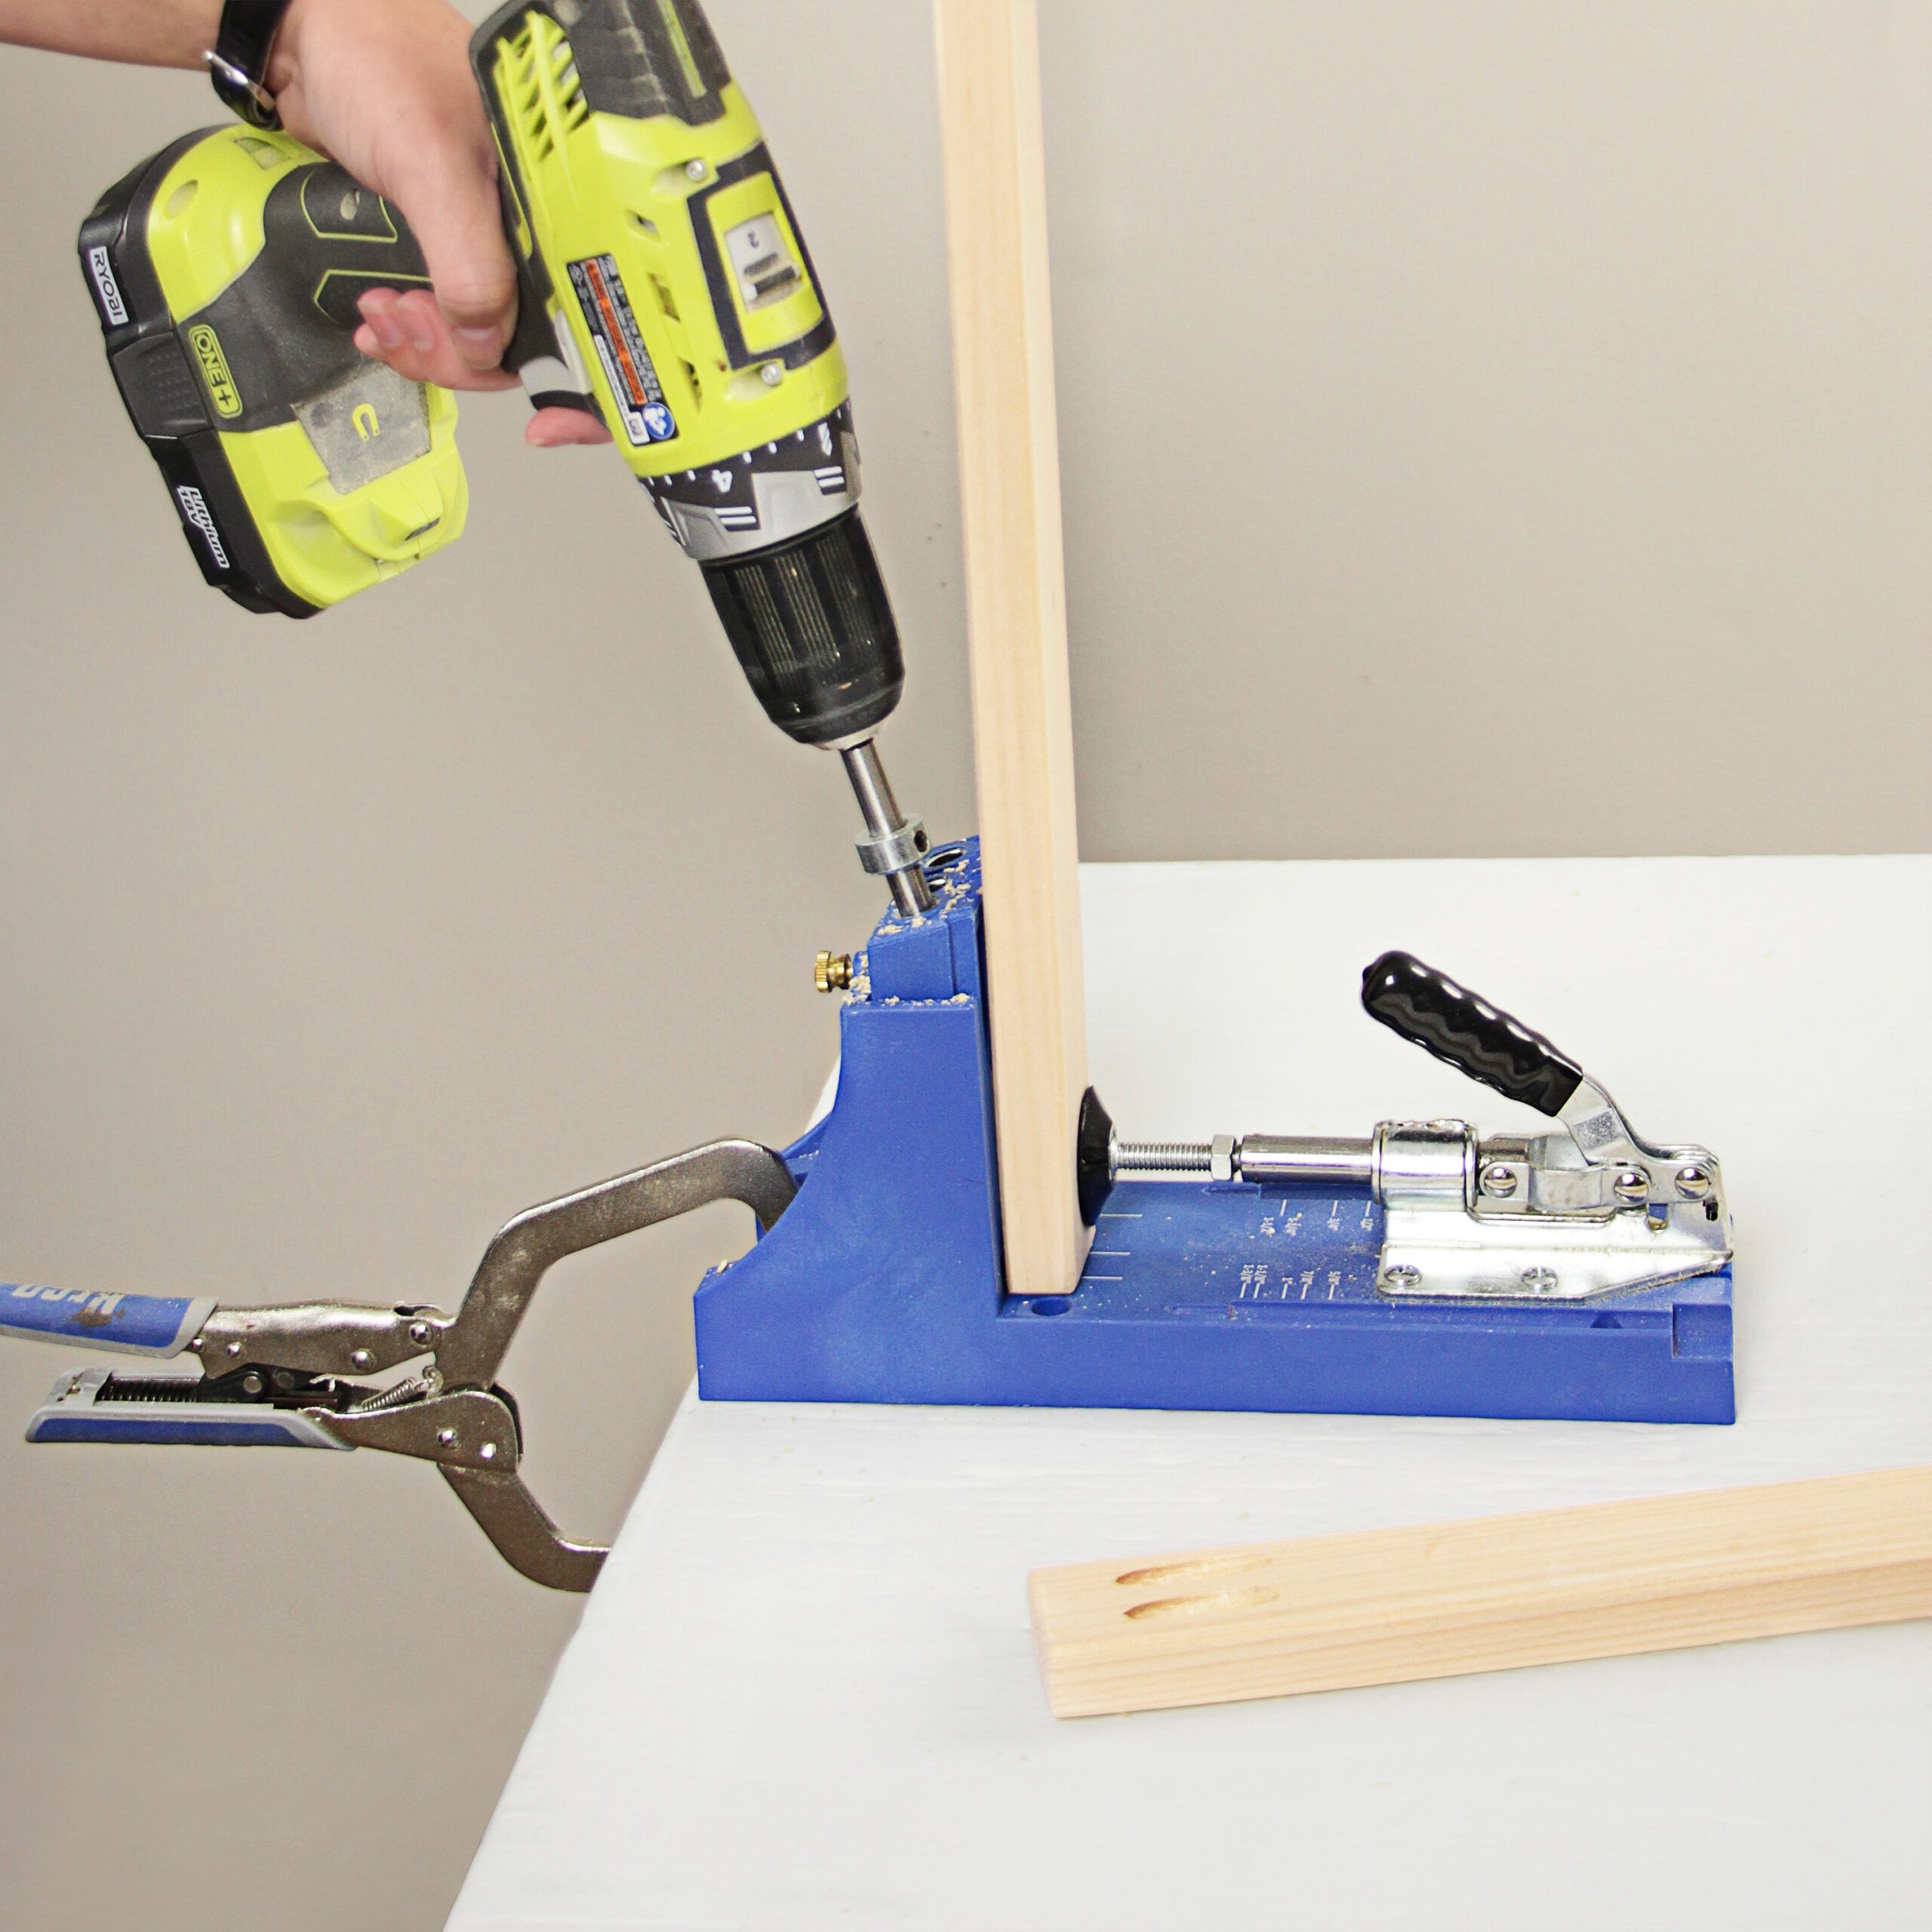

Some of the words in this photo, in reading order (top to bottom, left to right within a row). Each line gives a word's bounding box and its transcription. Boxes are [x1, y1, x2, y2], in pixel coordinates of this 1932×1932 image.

[94, 251, 122, 317] RYOBI
[195, 332, 232, 406] ONE+
[181, 489, 202, 525] 18V
[712, 469, 733, 494] 4
[189, 490, 227, 566] Lithium
